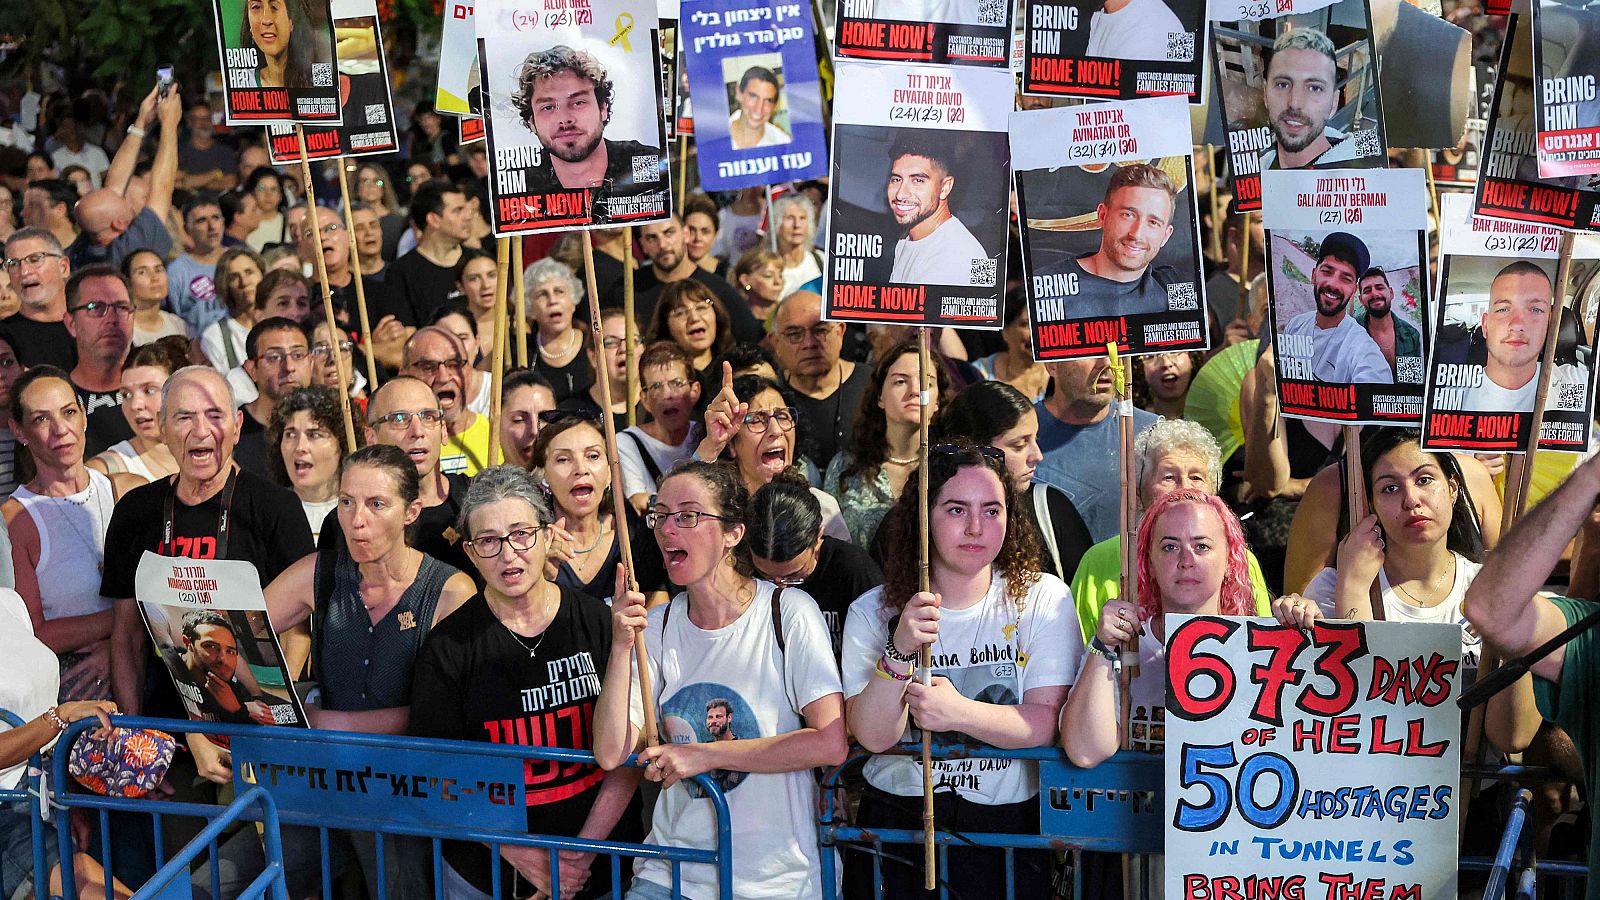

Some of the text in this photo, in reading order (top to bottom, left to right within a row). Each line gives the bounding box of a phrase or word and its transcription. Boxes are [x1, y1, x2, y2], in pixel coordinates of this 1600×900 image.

[512, 9, 592, 32] (24) (23) (22)
[691, 4, 800, 27] אין ניצחון בלי
[843, 0, 874, 19] HIM
[1032, 4, 1078, 31] BRING
[693, 26, 804, 53] סגן הדר גולדין
[842, 21, 934, 50] HOME NOW!
[948, 35, 1005, 46] HOSTAGES AND MISSING
[1031, 30, 1061, 55] HIM
[226, 47, 258, 67] BRING
[947, 44, 978, 57] FAMILIES
[979, 45, 1004, 58] FORUM
[228, 68, 250, 88] HER
[907, 74, 951, 90] אביתר דוד
[1030, 57, 1120, 87] HOME NOW!
[1137, 72, 1195, 82] HOSTAGES AND MISSING
[893, 89, 962, 106] EVYATAR DAVID
[1136, 79, 1195, 94] FAMILIES FORUM
[1543, 75, 1596, 104] BRING
[231, 89, 290, 111] HOME NOW!
[297, 104, 337, 114] FAMILIES FORUM
[947, 107, 964, 123] (22)
[1076, 109, 1124, 126] אבינתן אור
[1544, 105, 1578, 131] HIM
[273, 134, 298, 153] HOM
[306, 129, 340, 150] NOW!
[1072, 124, 1131, 143] AVINATAN OR
[1228, 127, 1272, 154] BRING
[1544, 133, 1593, 151] אנגרסט
[496, 146, 543, 169] BRING
[718, 151, 812, 178] עוז וענווה
[1232, 152, 1260, 176] HIM
[1486, 151, 1520, 179] HIM
[497, 170, 527, 195] HIM
[1352, 177, 1366, 192] גלי
[500, 189, 592, 222] HOME NOW!
[607, 197, 632, 205] HOSTAGES
[632, 195, 641, 203] AND
[608, 202, 664, 216] FAMILIES FORUM
[1297, 193, 1386, 207] GALI AND ZIV BERMAN
[1482, 180, 1529, 209] HOME
[1529, 189, 1580, 218] NOW!
[1319, 208, 1363, 225] (27) (26)
[1472, 218, 1491, 232] BAR
[836, 233, 882, 258] BRING
[834, 258, 864, 281] HIM
[1033, 272, 1079, 299] BRING
[833, 284, 926, 311] HOME NOW!
[941, 297, 997, 307] HOSTAGES AND MISSING
[941, 305, 996, 317] FAMILIES FORUM
[1035, 298, 1065, 322] HIM
[1038, 317, 1128, 348] HOME NOW!
[1143, 323, 1167, 333] HOSTAGES
[1168, 322, 1178, 331] AND
[1144, 329, 1200, 343] FAMILIES FORUM
[1278, 334, 1314, 358] BRING
[1280, 357, 1313, 380] THEM
[1435, 363, 1483, 388] BRING
[1281, 382, 1357, 411] HOME NOW!
[1372, 395, 1395, 403] HOSTAGES
[1396, 395, 1405, 403] AND
[1433, 388, 1464, 410] HIM
[1373, 403, 1422, 415] FAMILIES FORU
[1430, 413, 1475, 438] HOME
[1476, 413, 1520, 438] NOW!
[1552, 421, 1561, 430] AND
[1562, 422, 1584, 430] MISSING
[1558, 429, 1583, 442] FORUM
[167, 577, 218, 591] NIMROD COHEN
[178, 592, 197, 604] (20)
[994, 666, 1012, 677] 673
[1165, 616, 1459, 727] 673 DAYS
[521, 682, 568, 712] הביתה
[1241, 714, 1450, 757] OF HELL
[940, 773, 981, 790] HOME
[1173, 741, 1452, 832] 50 HOSTAGES
[1209, 836, 1415, 866] IN TUNNELS
[1184, 872, 1422, 900] BRING THEM
